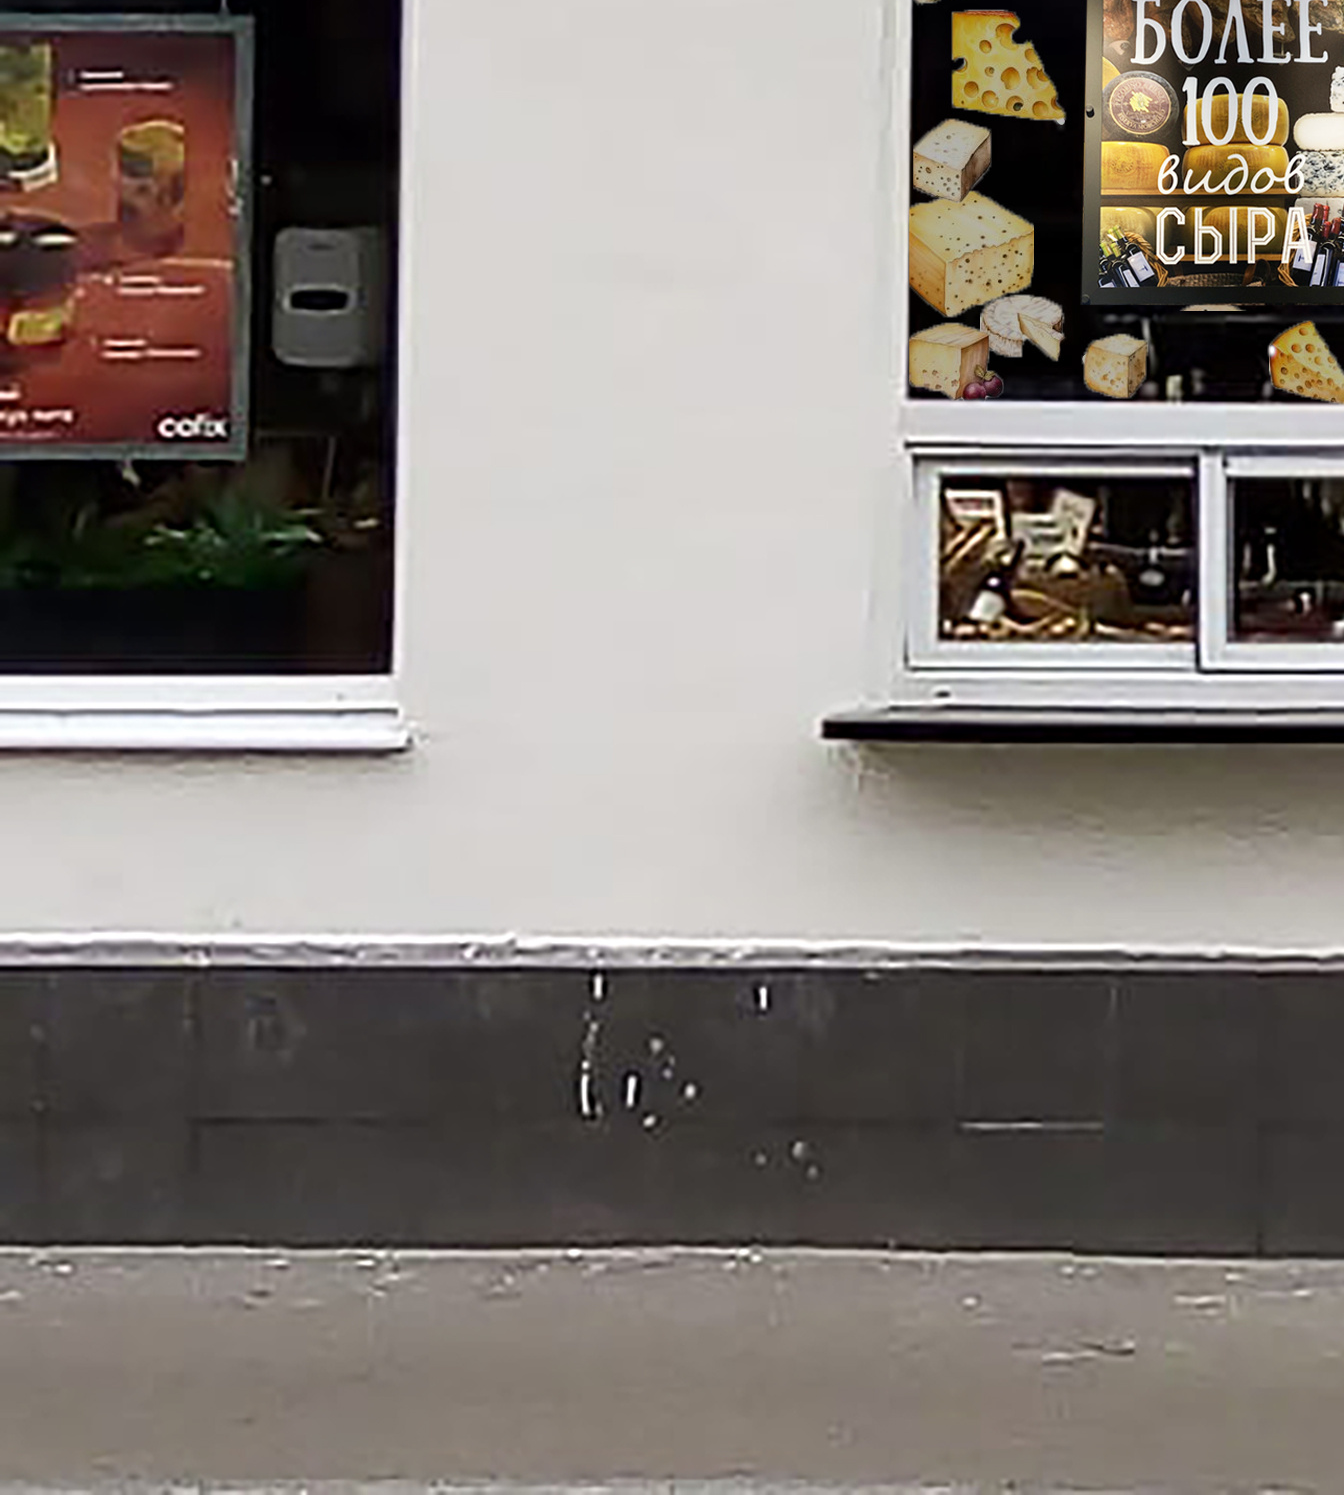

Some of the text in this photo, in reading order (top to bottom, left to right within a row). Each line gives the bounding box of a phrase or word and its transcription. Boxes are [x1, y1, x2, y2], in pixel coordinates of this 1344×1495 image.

[1182, 76, 1279, 147] 100
[1157, 153, 1306, 195] видов
[1155, 207, 1314, 266] СЫРА
